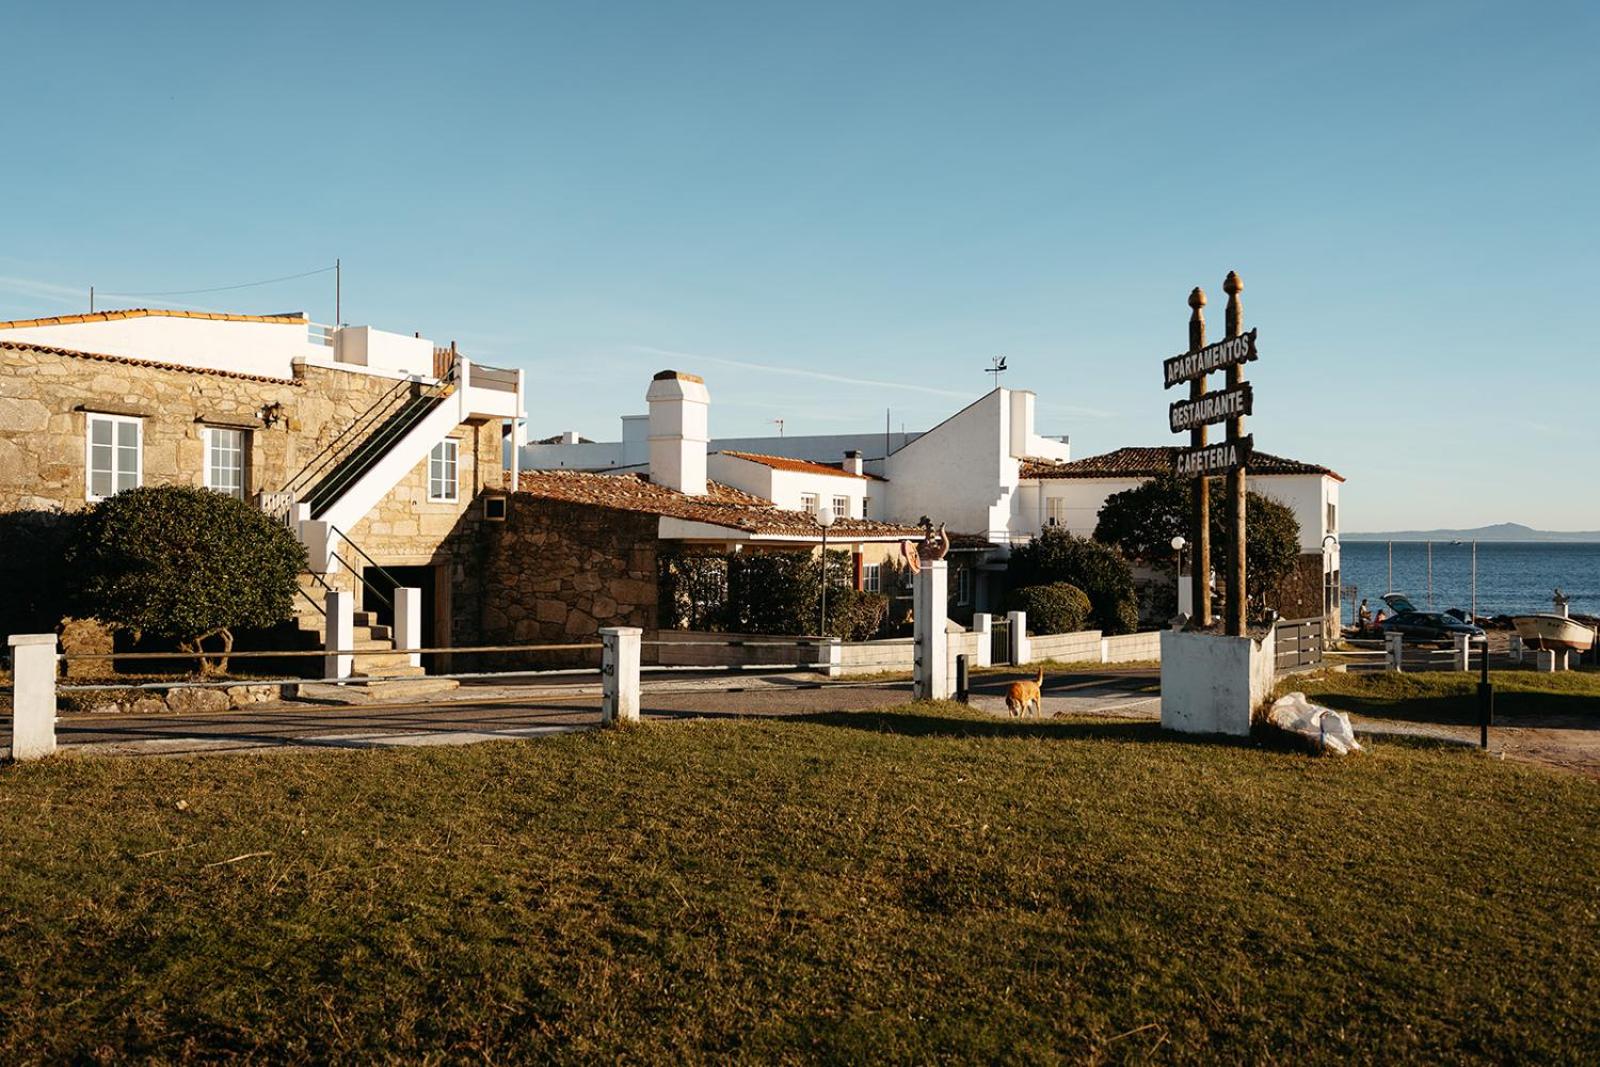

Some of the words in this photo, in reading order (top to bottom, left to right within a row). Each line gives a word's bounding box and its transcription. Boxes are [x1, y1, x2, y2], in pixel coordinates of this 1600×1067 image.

[1167, 335, 1249, 382] APARTAMENTOS
[1172, 390, 1243, 427] RESTAURANTE
[1177, 445, 1237, 473] CAFETERIA
